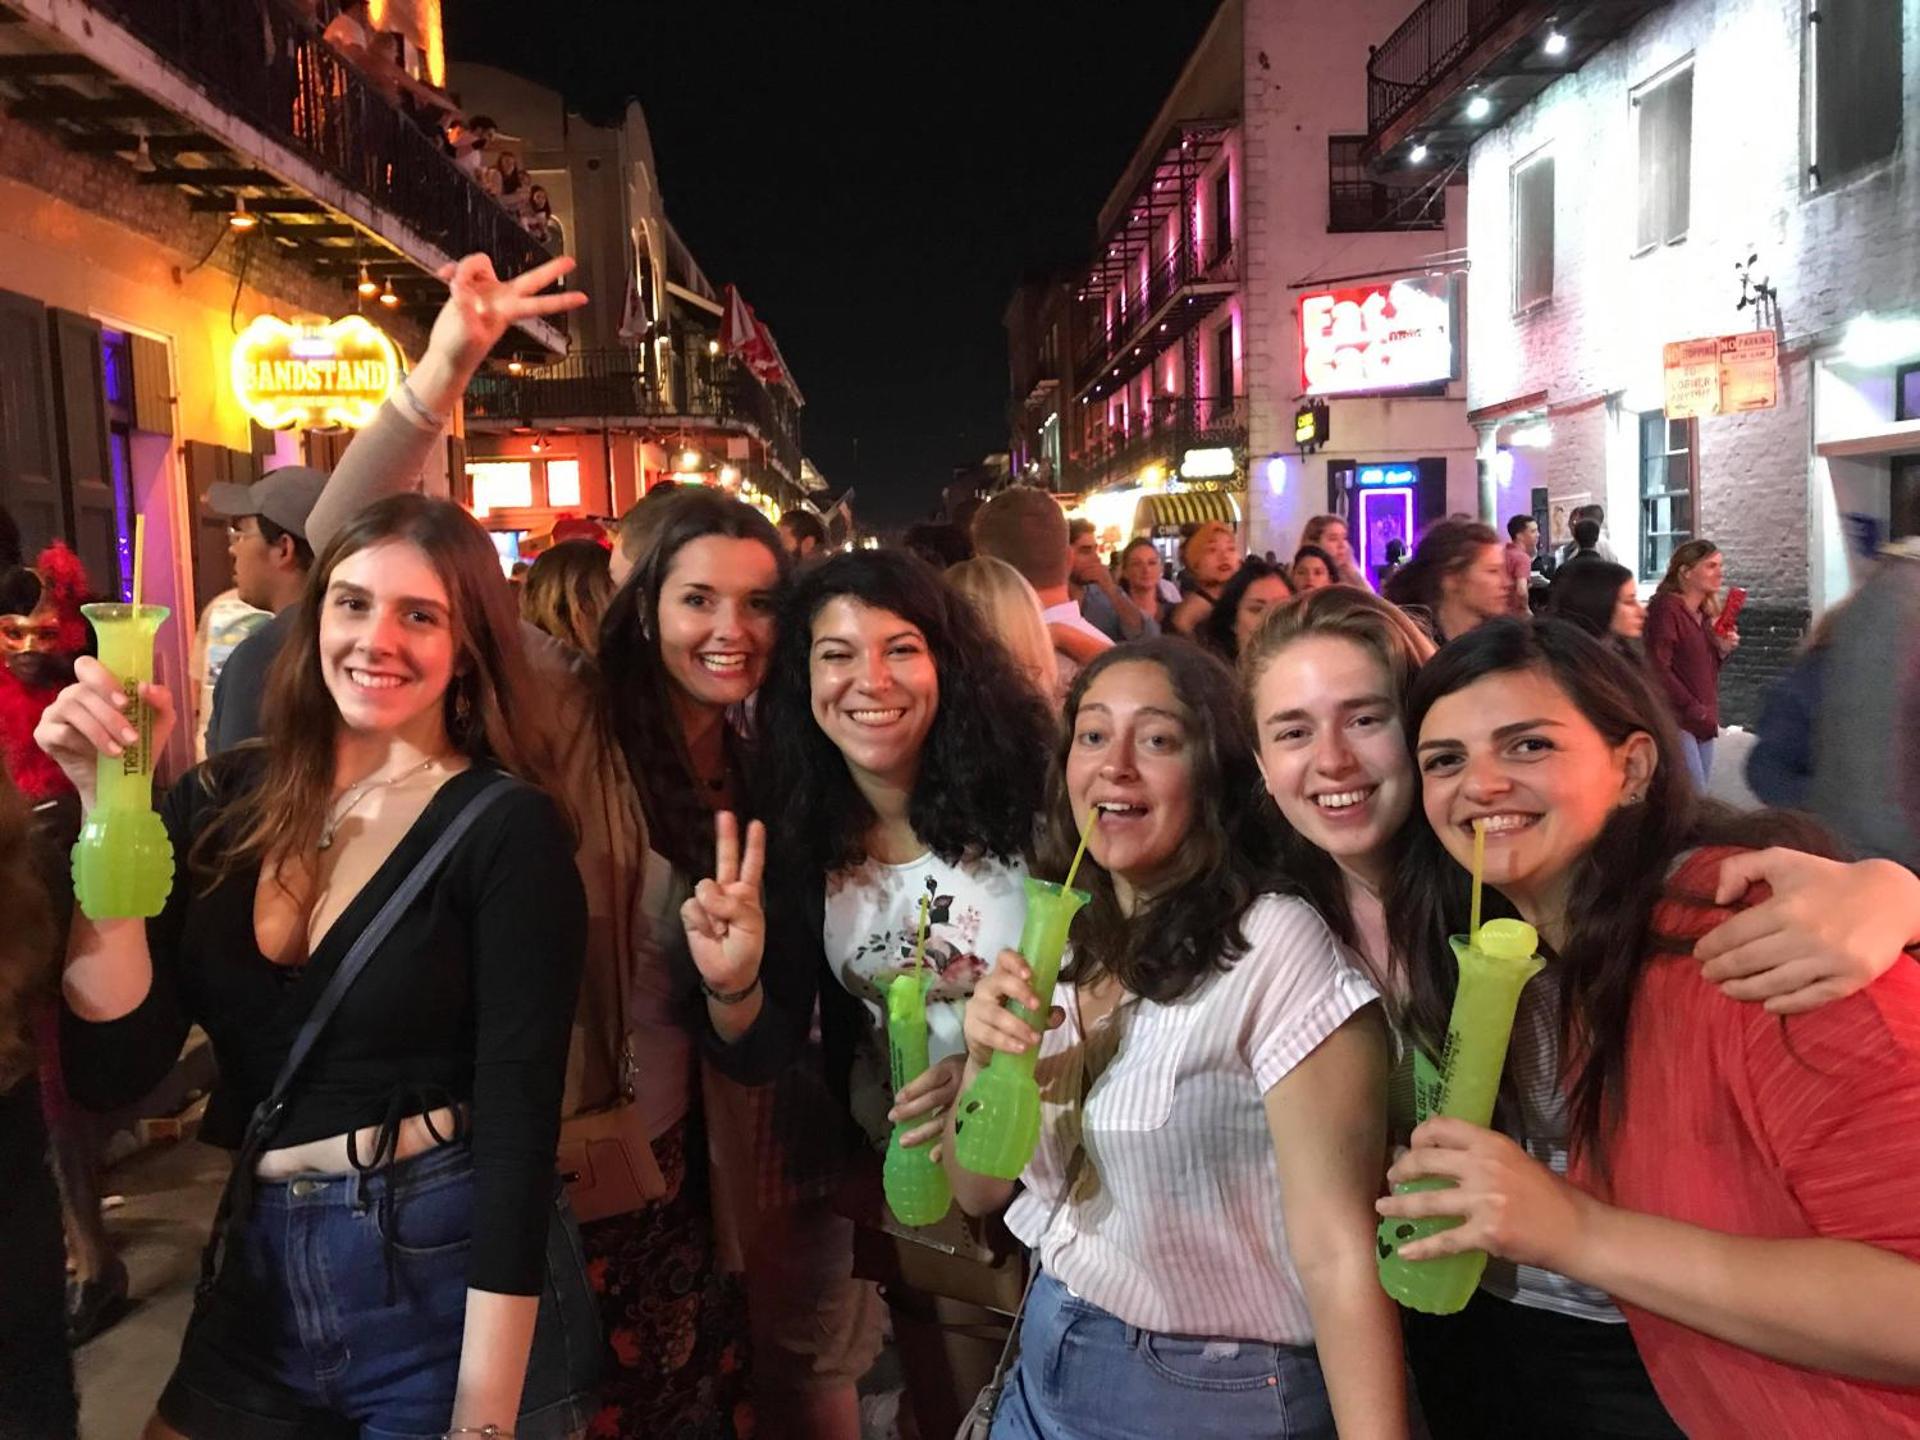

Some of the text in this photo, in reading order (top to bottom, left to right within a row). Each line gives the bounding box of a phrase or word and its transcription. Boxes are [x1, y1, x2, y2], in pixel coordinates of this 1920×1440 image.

[1720, 335, 1772, 351] NO PARKING
[245, 359, 386, 391] BANDSTAND
